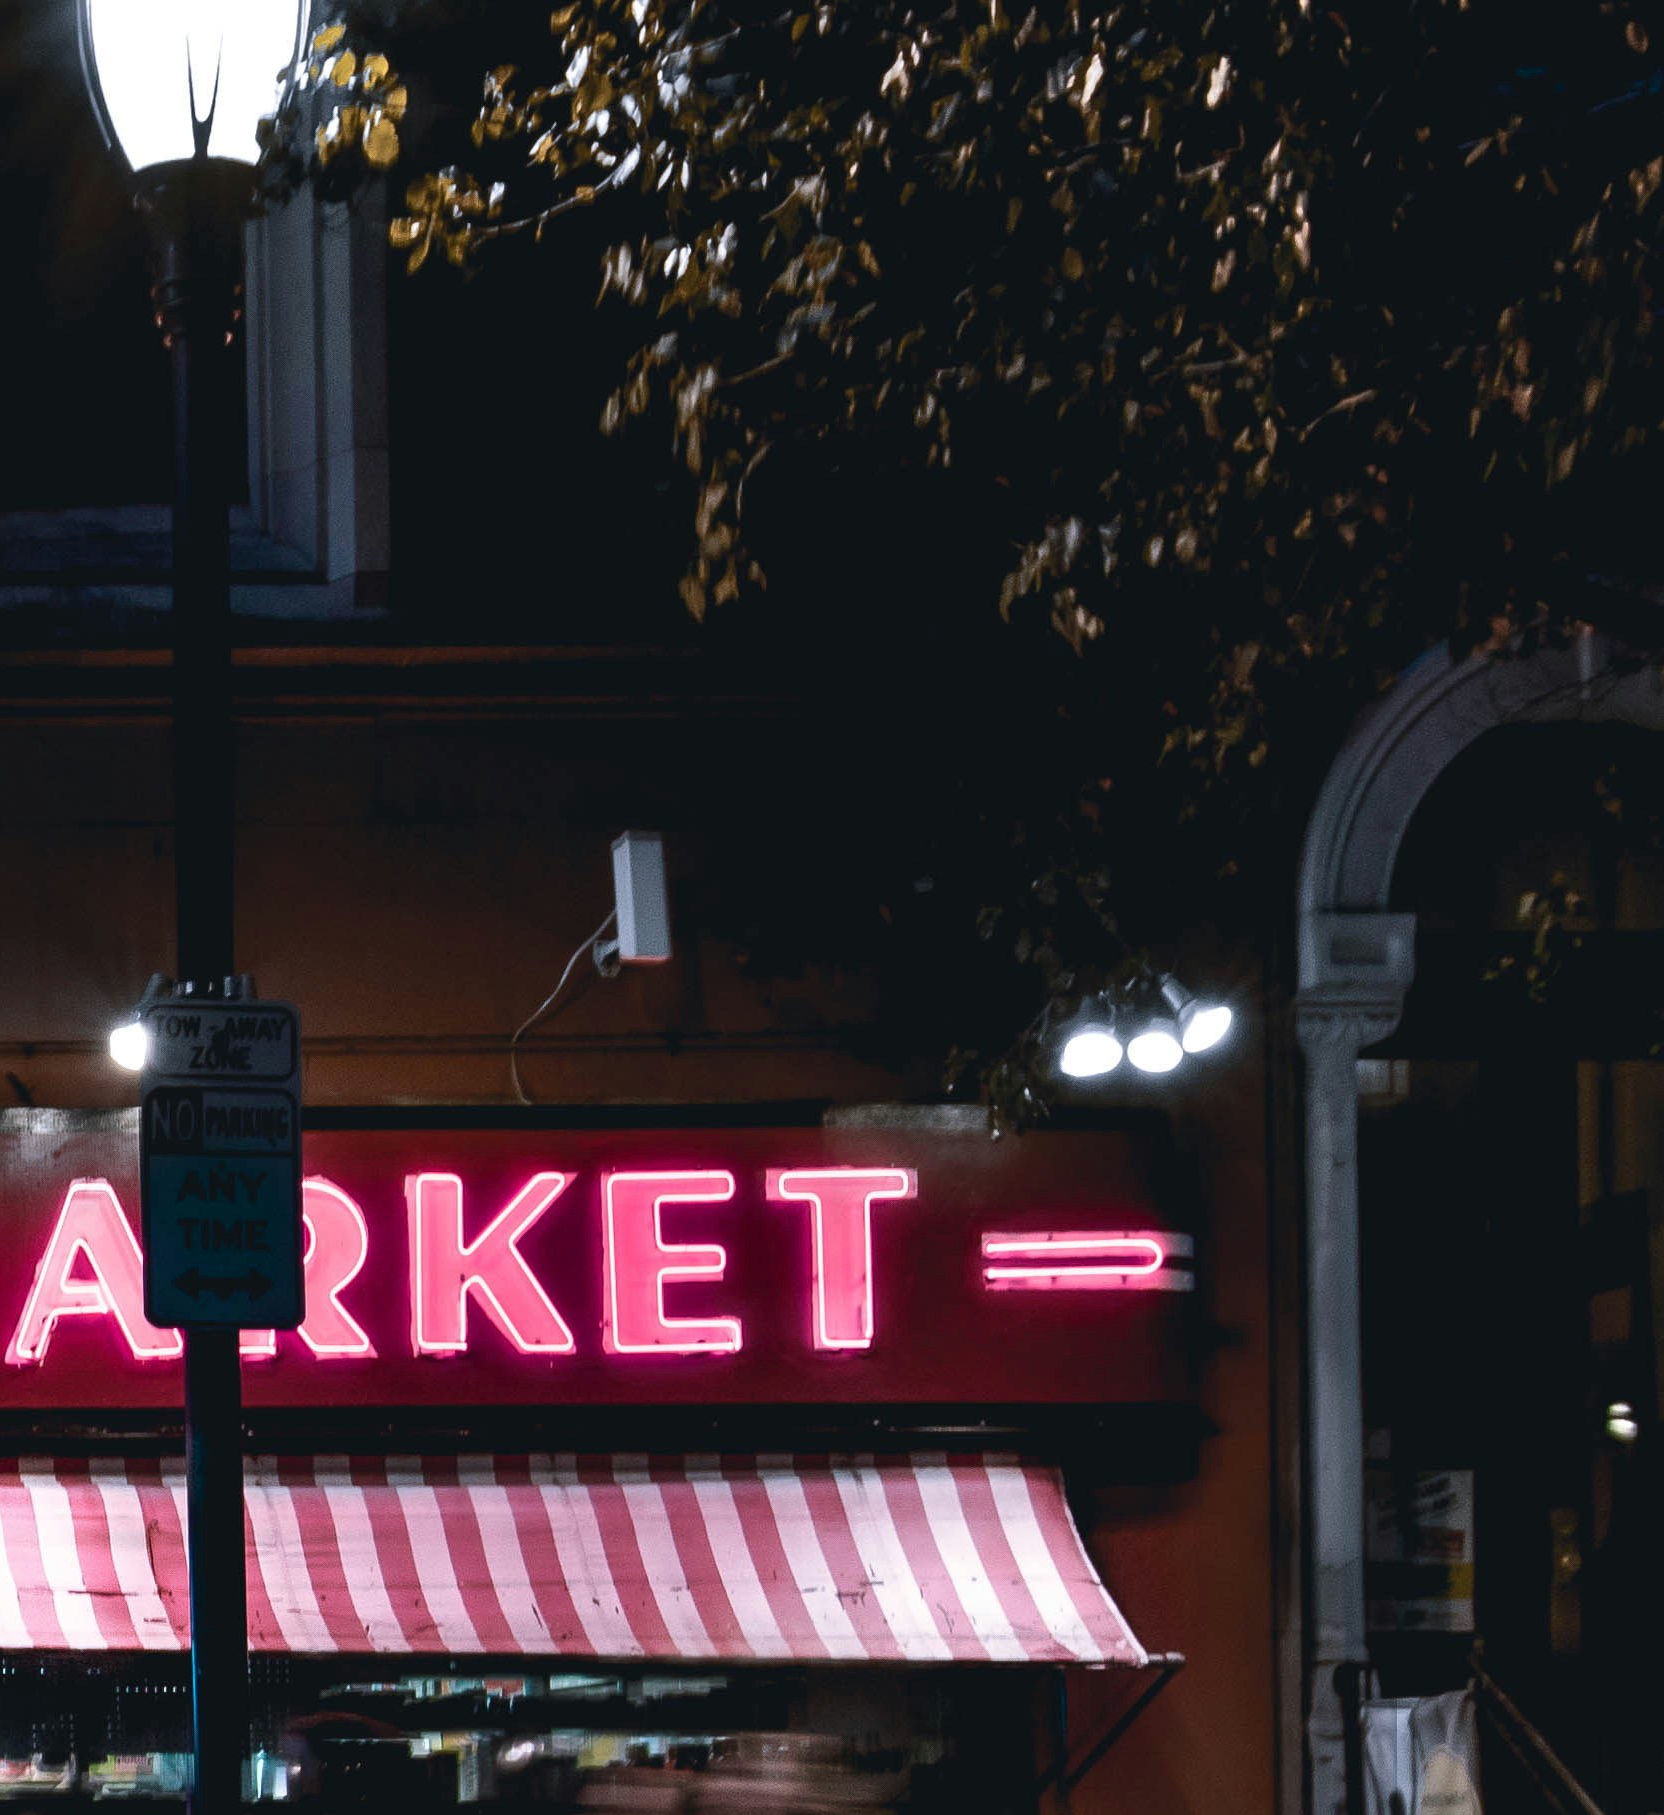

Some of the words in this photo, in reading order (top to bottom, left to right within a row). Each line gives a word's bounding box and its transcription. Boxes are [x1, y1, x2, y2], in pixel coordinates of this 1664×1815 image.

[188, 1046, 253, 1071] ZONE
[151, 1097, 196, 1143] NO
[204, 1106, 289, 1140] PARKING
[177, 1170, 268, 1202] ANY
[176, 1218, 271, 1252] TIME
